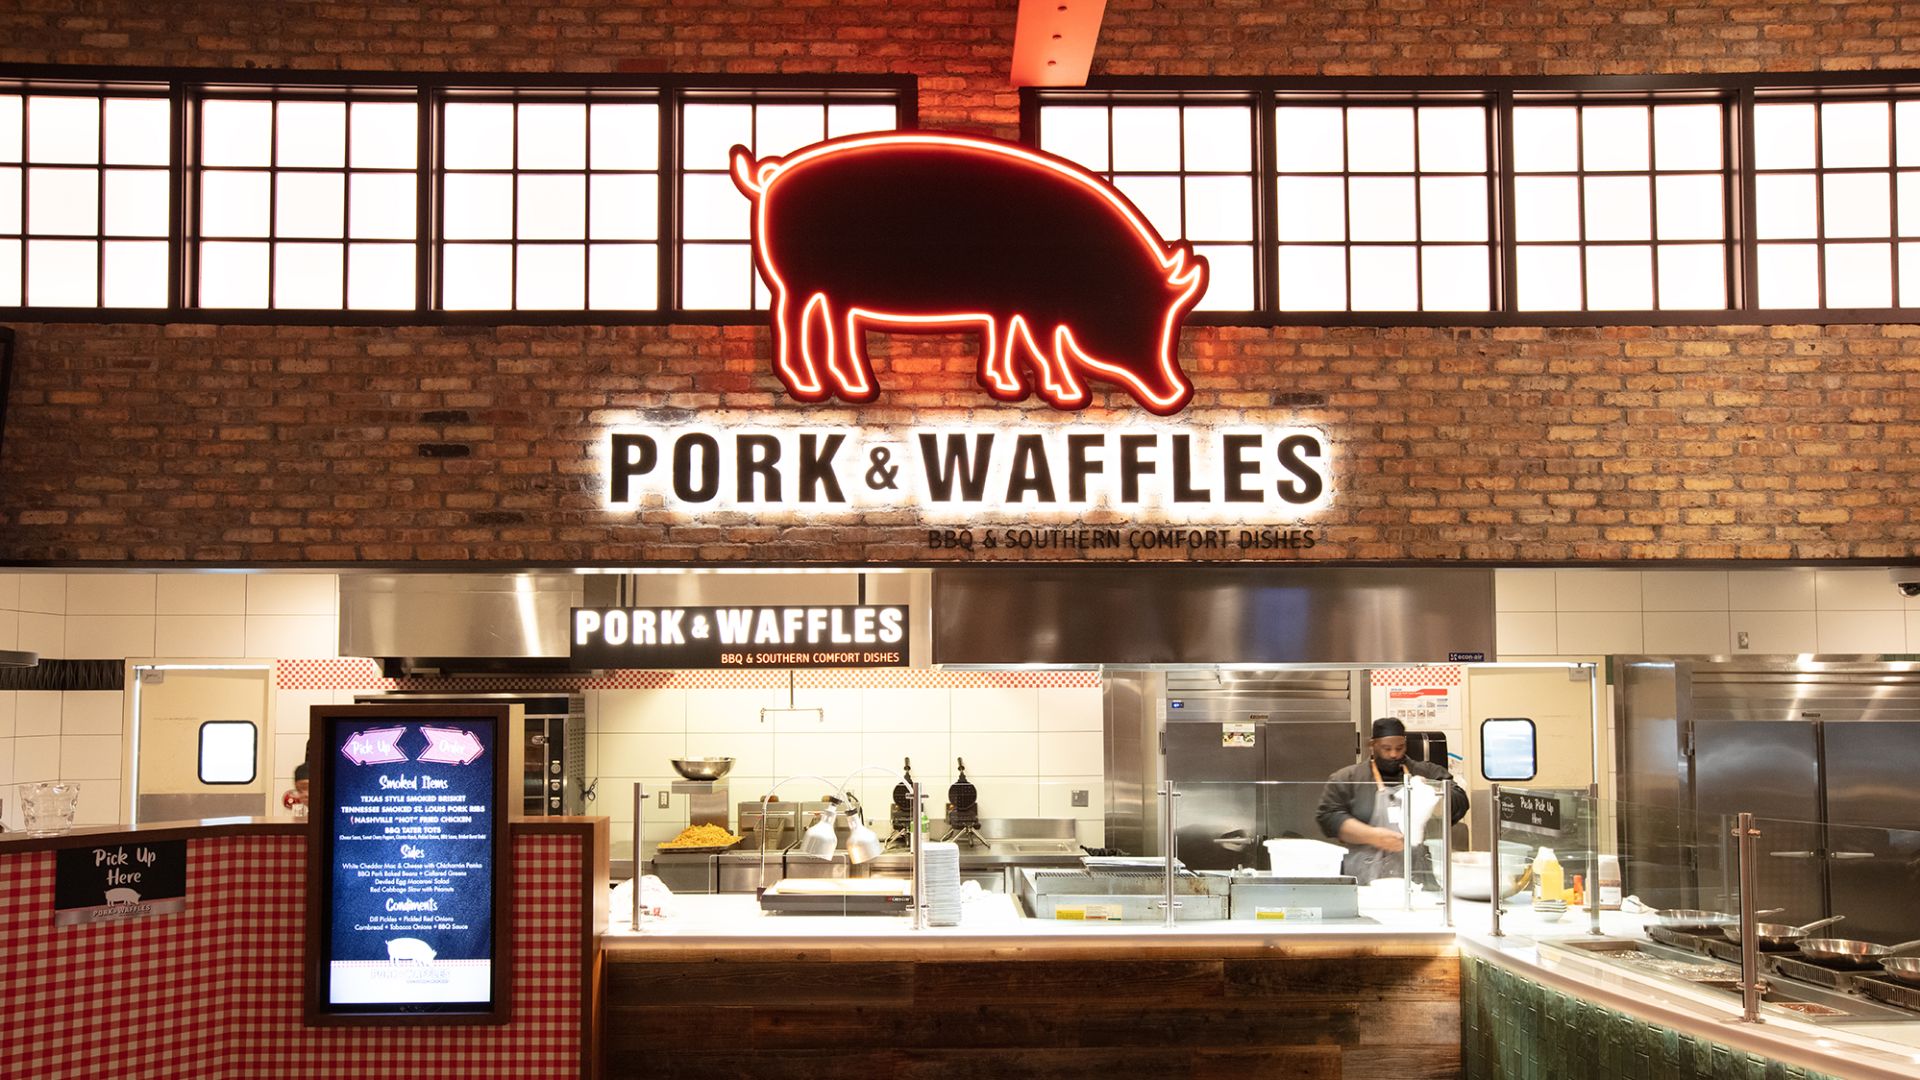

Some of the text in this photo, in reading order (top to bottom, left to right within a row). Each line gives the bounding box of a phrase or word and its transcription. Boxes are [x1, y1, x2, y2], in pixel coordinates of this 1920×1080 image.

[611, 432, 1324, 504] PORK & WAFFLES
[928, 529, 1316, 551] BBQ & SOUTHERN COMFORT DISHES
[576, 607, 903, 645] PORK & WAFFLES
[721, 652, 900, 665] BBQ & SOUTHERN COMFORT DISHES
[352, 739, 392, 756] Pick Up
[379, 774, 449, 790] Smoked Items
[92, 846, 157, 868] Pick Up
[400, 844, 425, 860] Sides
[106, 867, 142, 886] Here
[386, 898, 438, 912] Condiments
